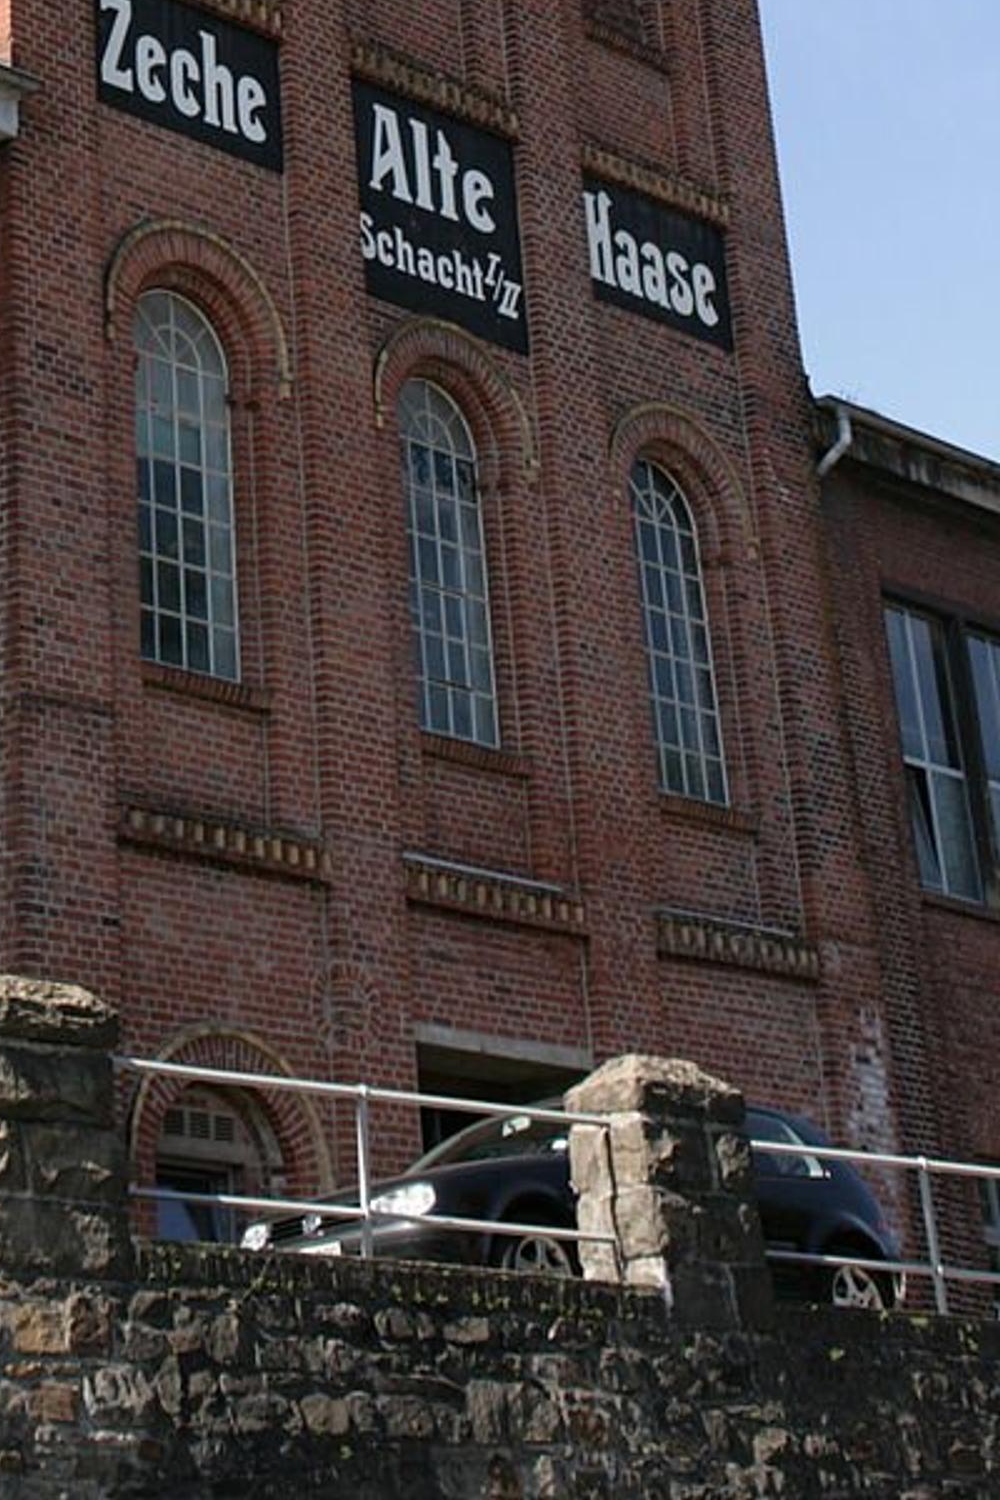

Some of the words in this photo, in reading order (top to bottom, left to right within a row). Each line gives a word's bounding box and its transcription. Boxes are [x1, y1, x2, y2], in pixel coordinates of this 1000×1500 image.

[368, 102, 496, 234] Alte
[359, 211, 486, 301] Schacht
[582, 190, 719, 327] Haase
